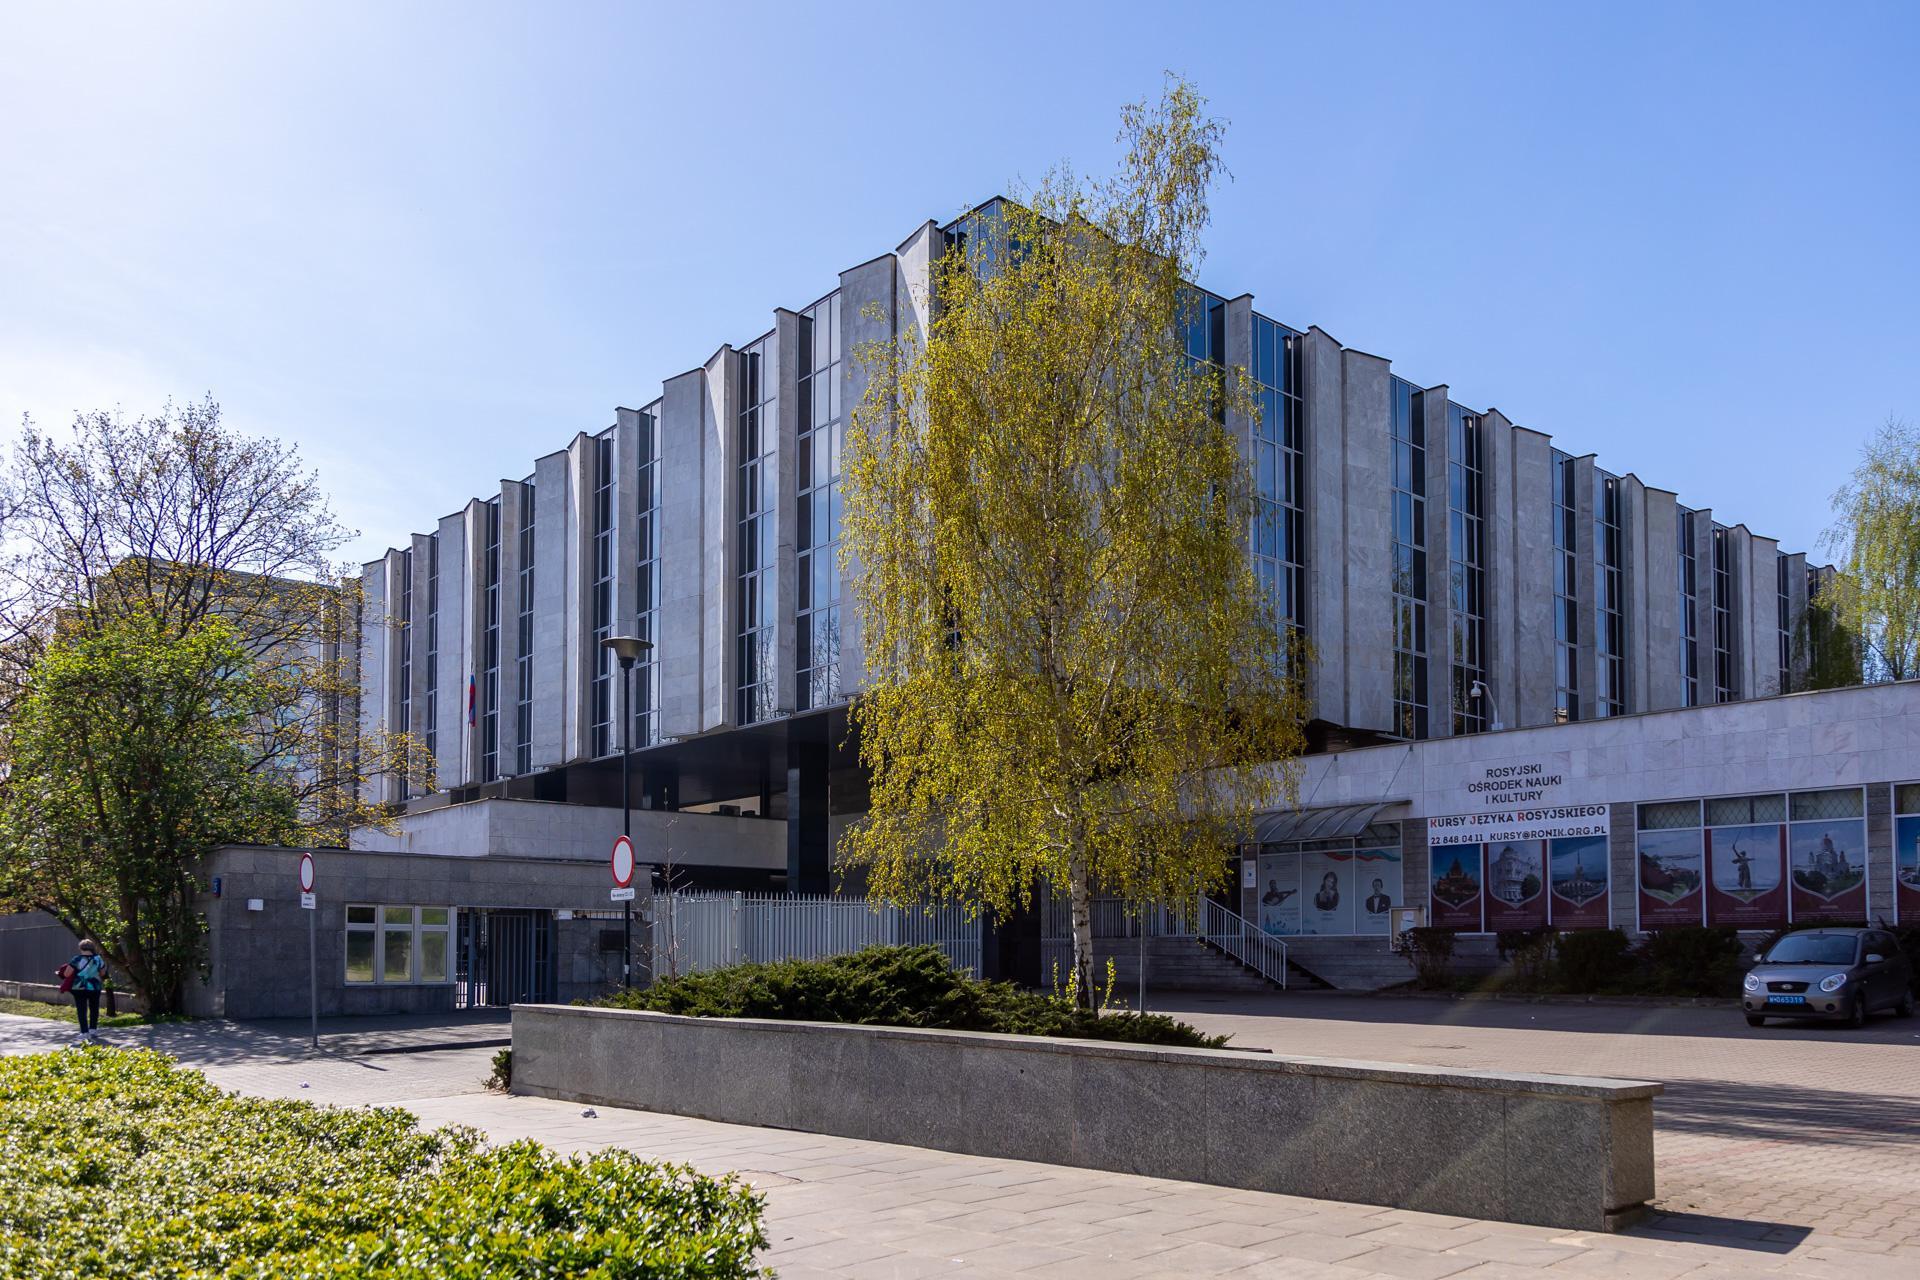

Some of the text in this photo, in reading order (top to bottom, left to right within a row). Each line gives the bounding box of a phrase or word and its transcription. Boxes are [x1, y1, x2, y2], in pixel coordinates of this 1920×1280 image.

[1486, 763, 1542, 778] ROSYJSKI
[1468, 775, 1562, 793] OŚRODEK NAUKI
[1485, 790, 1543, 805] I KULTURY
[1430, 805, 1606, 828] KURSY JĘZYKA ROSYJSKIEGO
[1431, 826, 1606, 845] 22 848 04 11 KURSY@RONIK.ORG.PL
